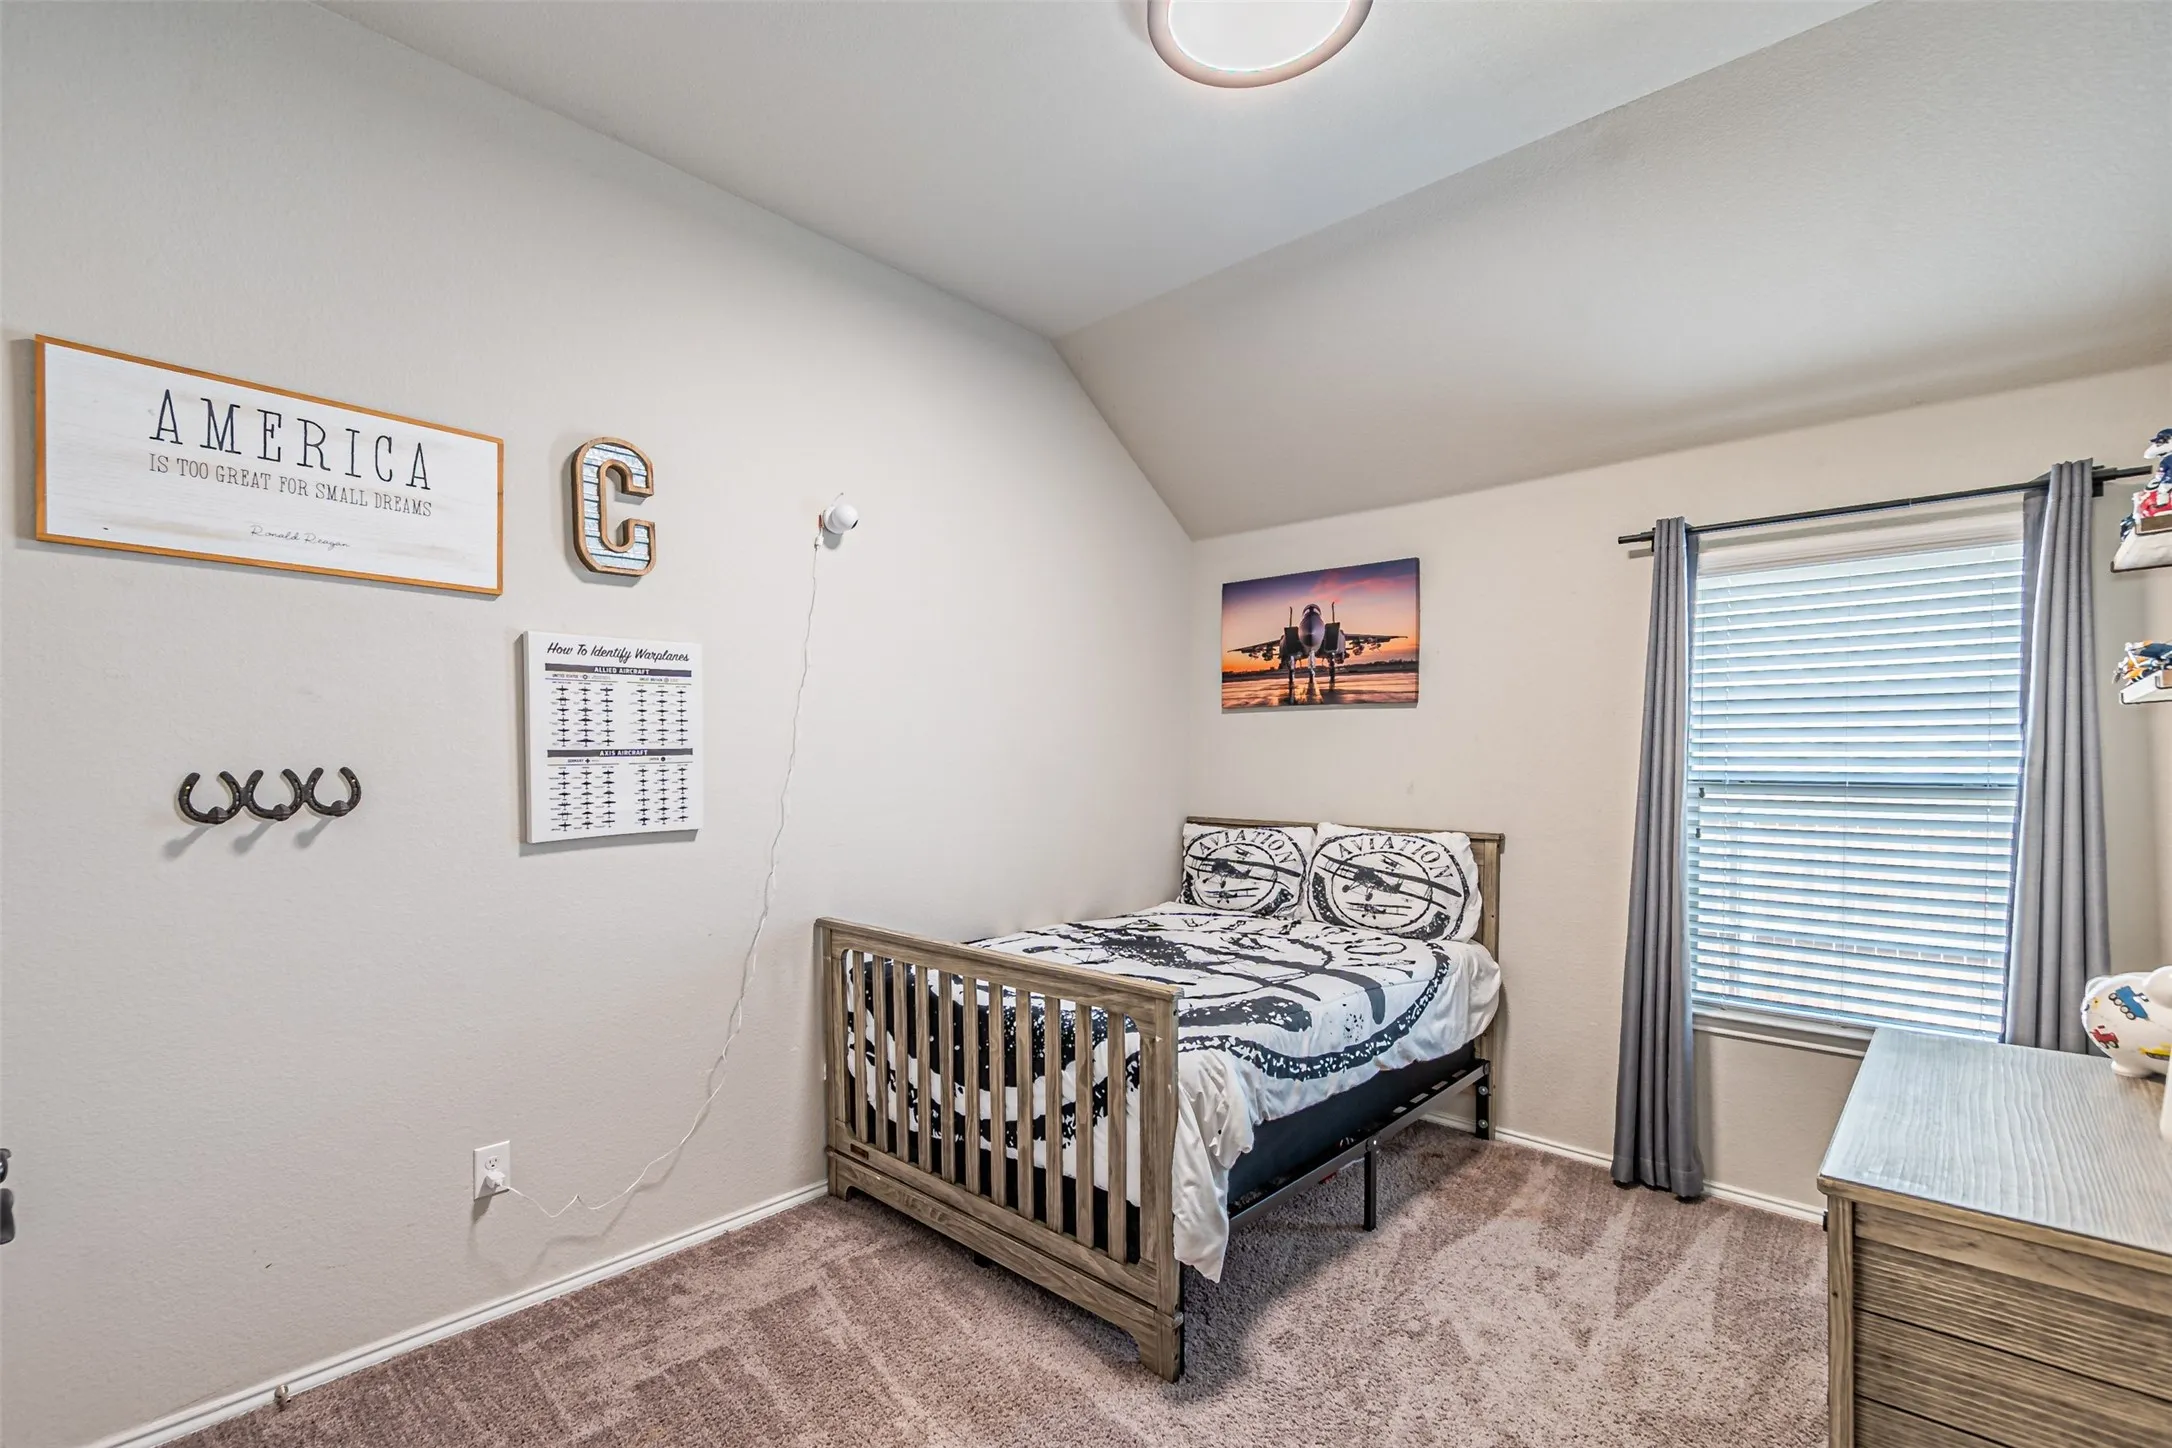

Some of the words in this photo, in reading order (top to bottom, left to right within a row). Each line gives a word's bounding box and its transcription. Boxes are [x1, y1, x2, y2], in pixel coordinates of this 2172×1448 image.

[149, 389, 430, 490] AMERICA
[149, 452, 169, 474] IS
[177, 457, 209, 480] TOO
[215, 465, 271, 490] GREAT
[279, 475, 309, 497] FOR
[315, 482, 368, 507] SMALL
[374, 491, 432, 517] DREAMS
[571, 437, 656, 577] C
[249, 524, 301, 541] Ronald
[303, 532, 351, 551] Reagan
[547, 642, 574, 656] How
[576, 643, 589, 657] To
[590, 644, 632, 664] Identify
[634, 648, 691, 663] Warplanes
[594, 666, 618, 675] ALLIED
[618, 667, 651, 676] AIRCRAFT
[617, 749, 649, 757] AIRCRAFT
[1199, 829, 1297, 864] AVIATION
[1338, 836, 1455, 879] AVIATION
